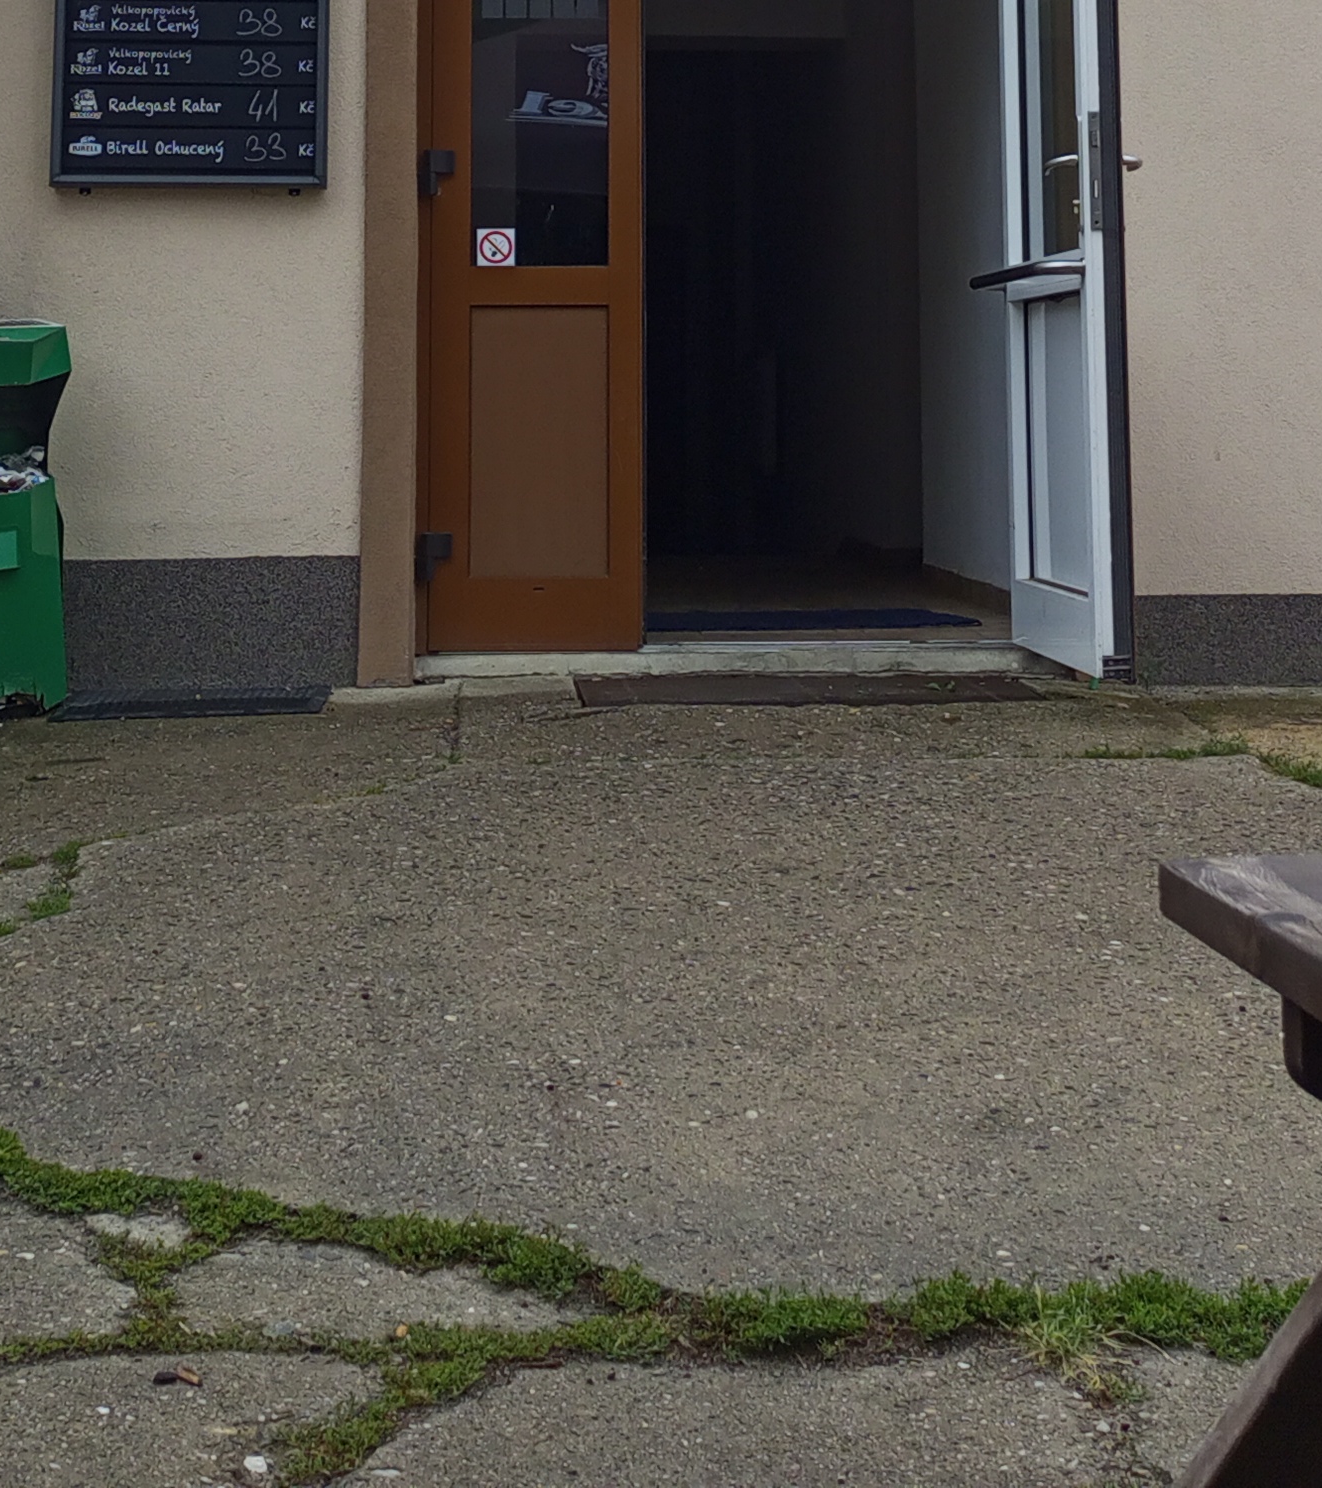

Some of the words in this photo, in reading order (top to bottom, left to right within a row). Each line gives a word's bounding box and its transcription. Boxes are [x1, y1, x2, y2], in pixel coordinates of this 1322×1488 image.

[110, 17, 151, 32] Kozel
[156, 15, 200, 39] Černý
[235, 8, 283, 38] 38
[300, 16, 317, 30] Kč
[111, 3, 196, 21] Velkopopovický
[107, 61, 148, 76] Kozel
[154, 63, 171, 76] 11
[238, 48, 283, 79] 38
[298, 59, 315, 73] Kč
[108, 47, 192, 65] Velkopopovický
[108, 95, 177, 117] Radegast
[182, 97, 223, 114] Ratar
[247, 88, 278, 123] 41
[298, 100, 316, 114] Kč
[106, 139, 149, 155] Birell
[154, 140, 225, 164] Ochucený
[243, 132, 287, 163] 33
[298, 143, 315, 157] Kč
